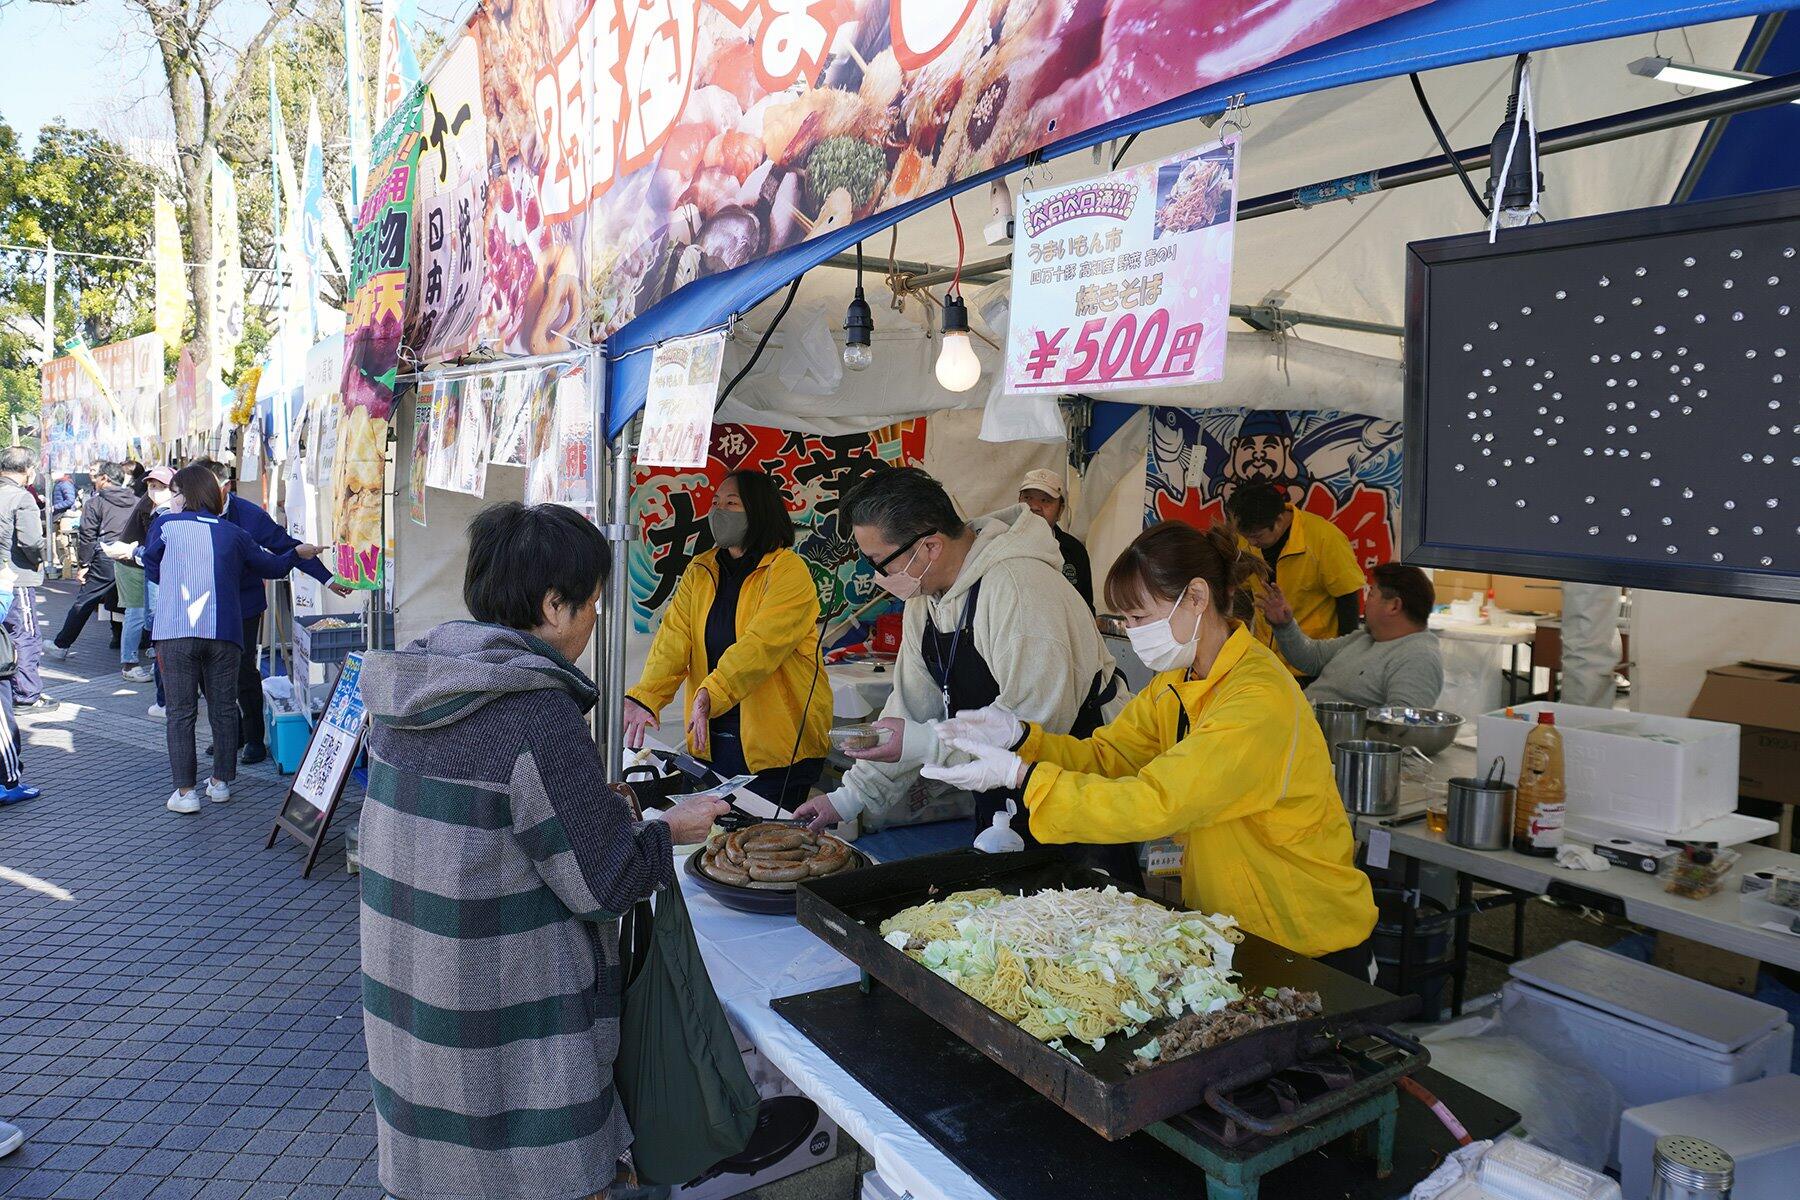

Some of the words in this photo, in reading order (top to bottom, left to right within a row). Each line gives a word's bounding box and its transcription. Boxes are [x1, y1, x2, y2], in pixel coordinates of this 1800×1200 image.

[1033, 189, 1127, 226] ベロベロ通り
[1027, 228, 1123, 264] うまいもん市
[1079, 257, 1115, 279] 高知産
[1117, 252, 1143, 272] 野菜
[1145, 244, 1178, 268] 青のり
[1075, 273, 1163, 317] 焼きそば
[717, 427, 748, 458] 祝
